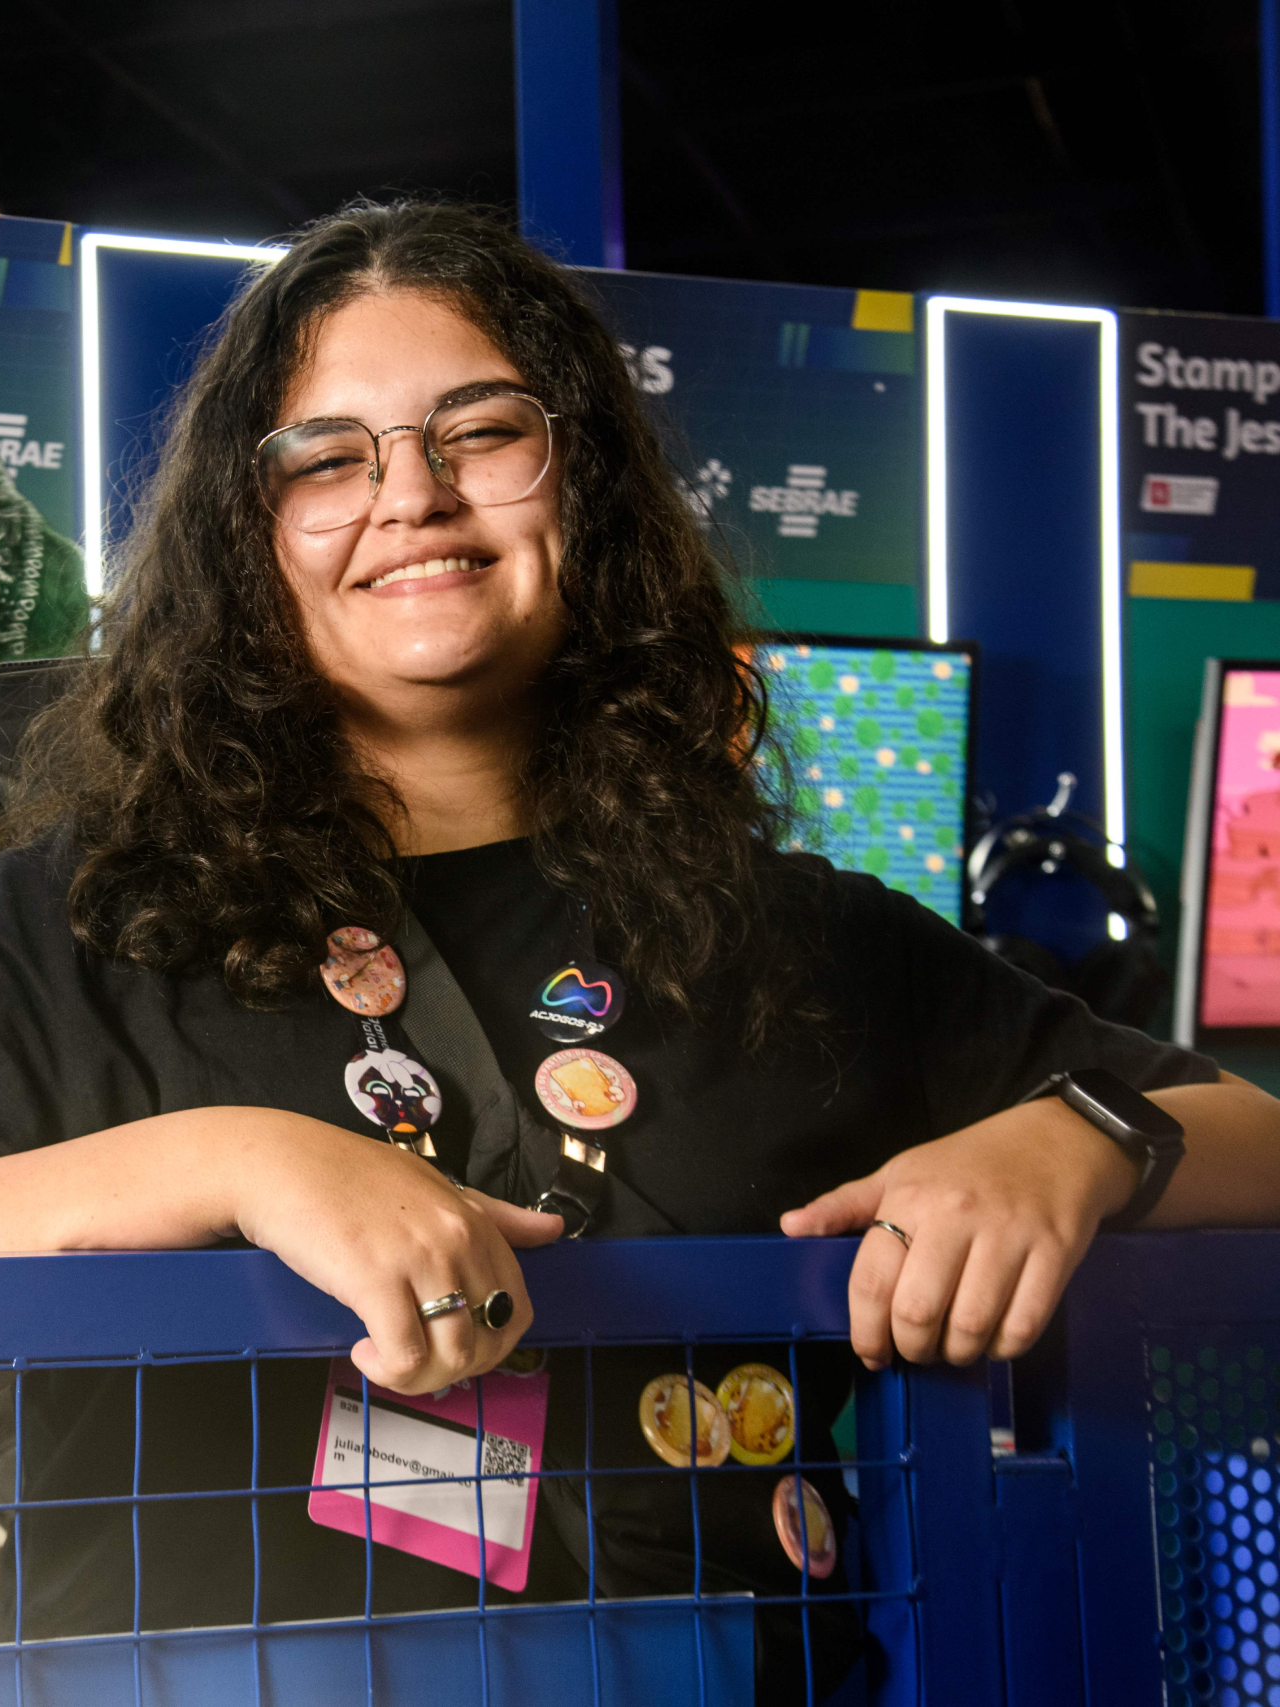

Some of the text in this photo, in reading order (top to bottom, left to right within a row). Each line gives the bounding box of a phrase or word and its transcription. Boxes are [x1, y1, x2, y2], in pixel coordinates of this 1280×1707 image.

[1136, 341, 1280, 404] Stamp
[1136, 402, 1218, 451] The
[749, 485, 859, 517] SEBRAE
[339, 1401, 359, 1414] B2B
